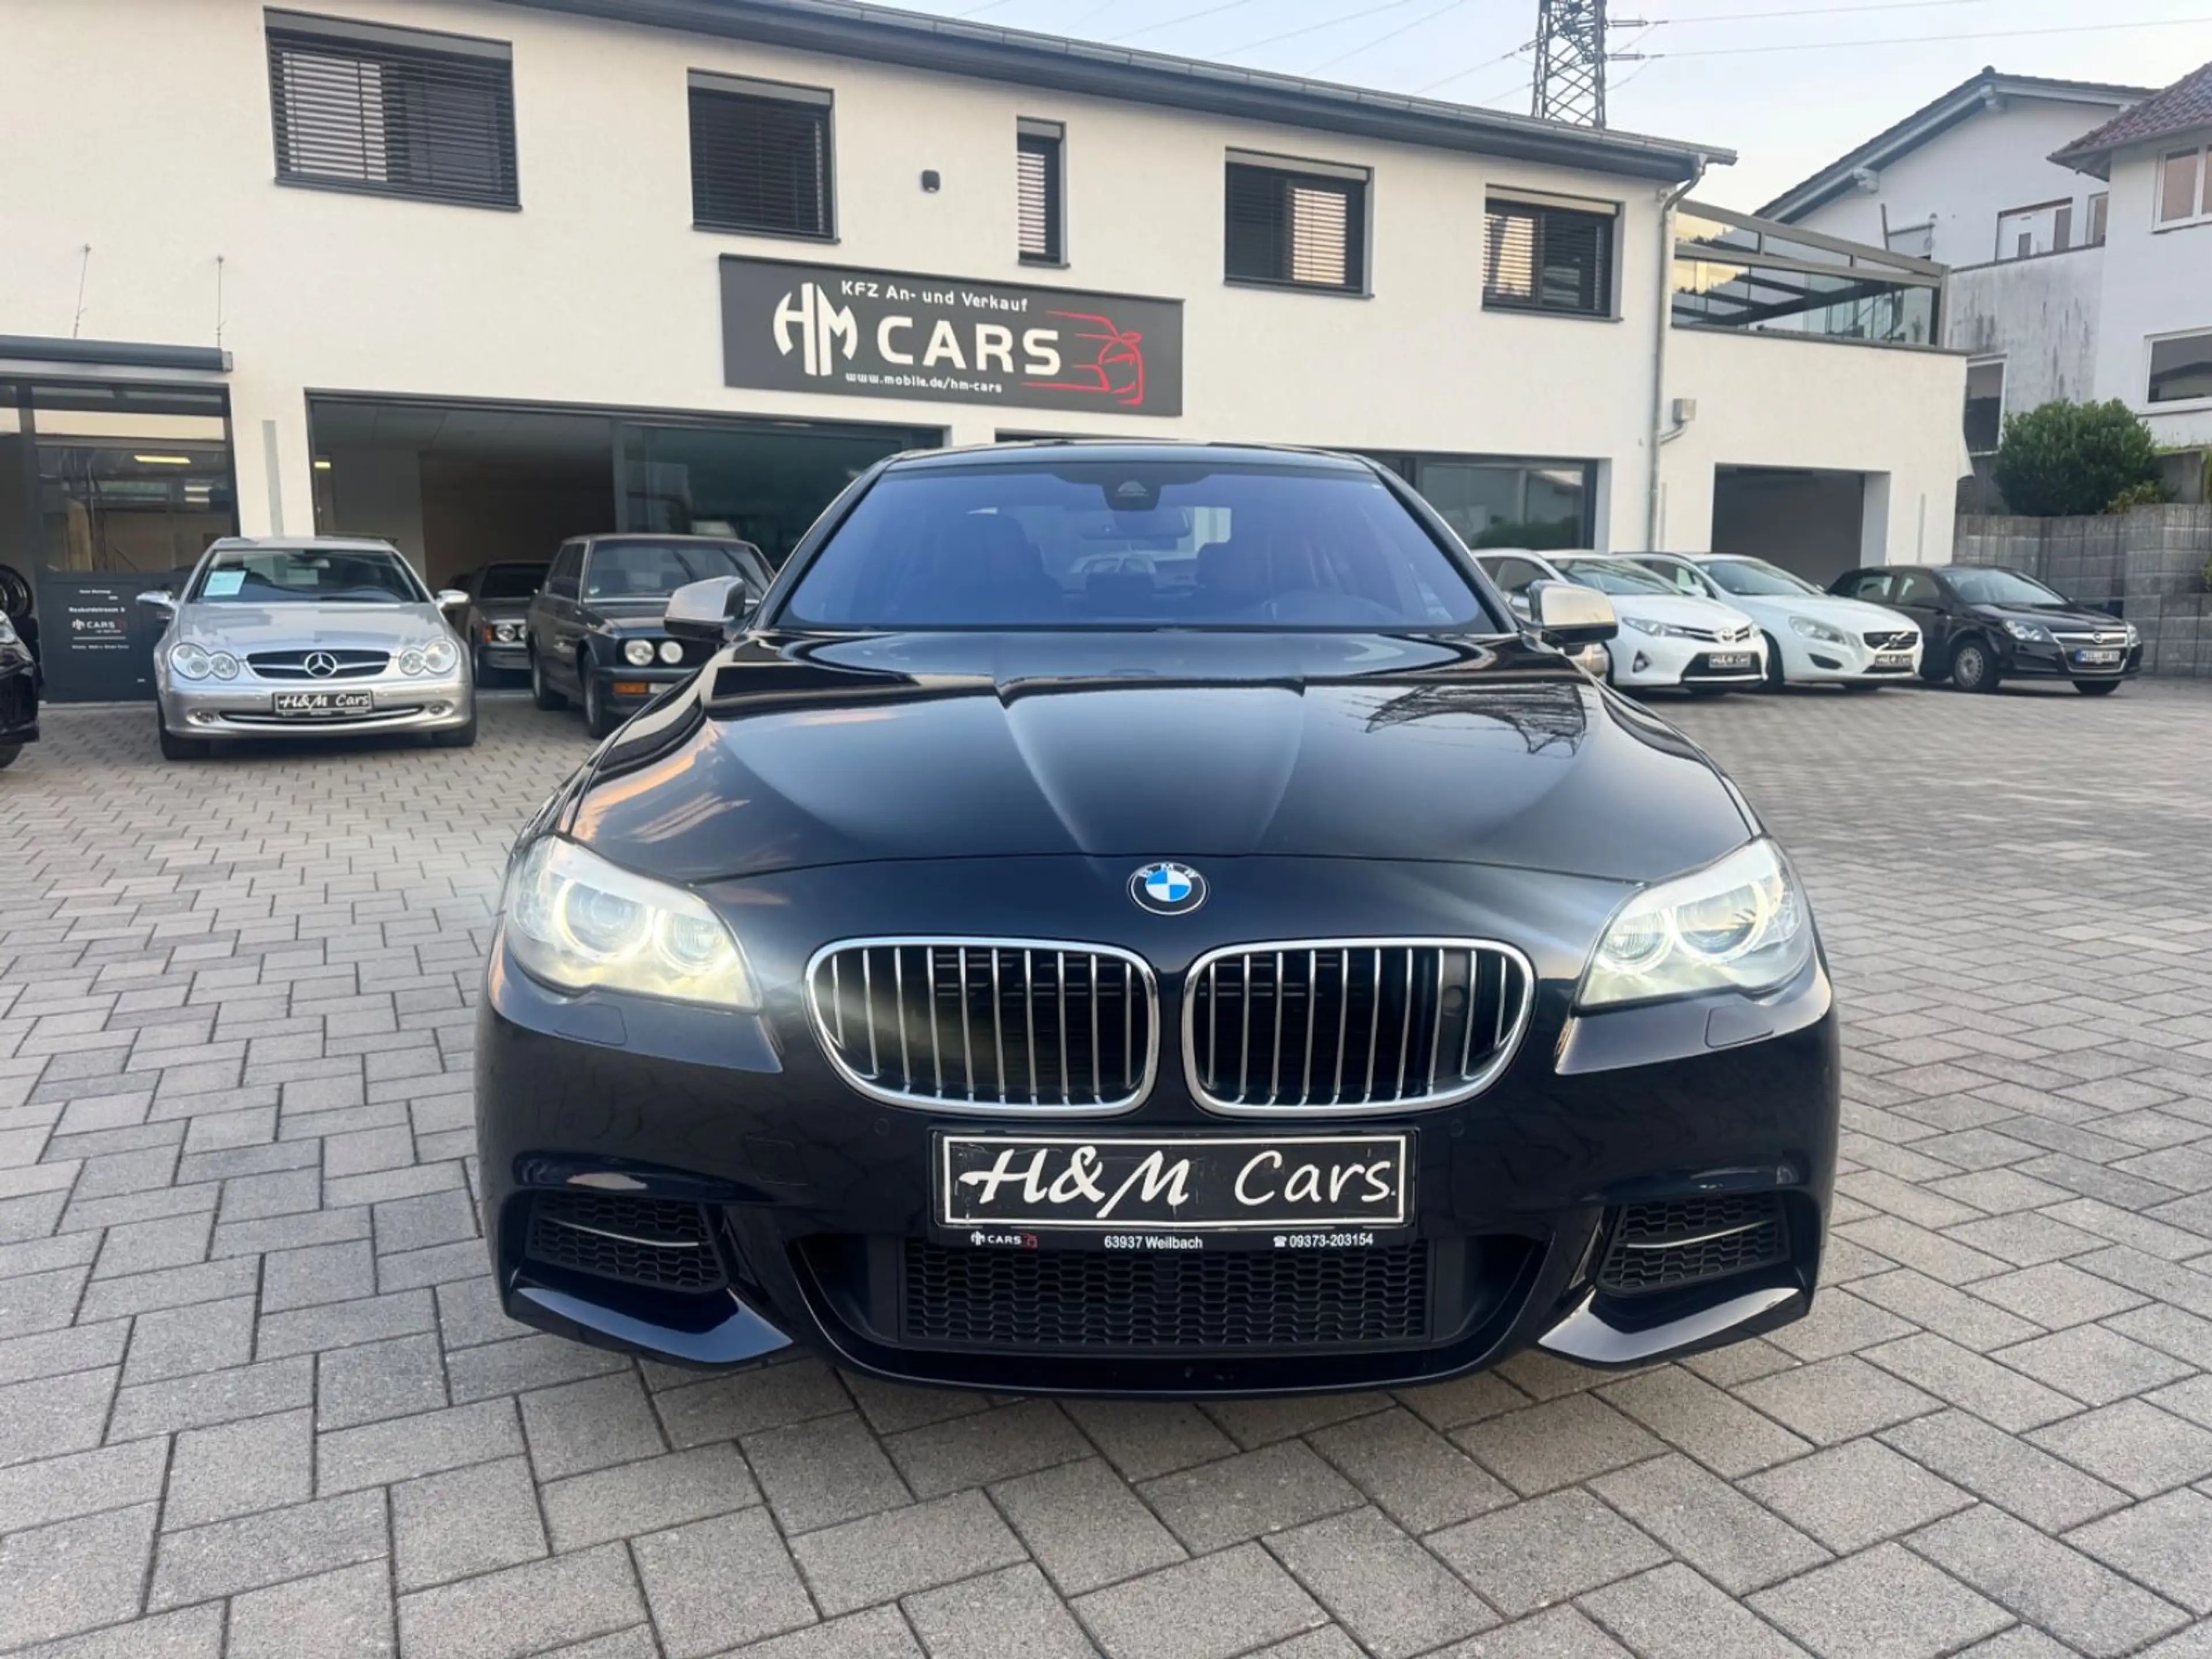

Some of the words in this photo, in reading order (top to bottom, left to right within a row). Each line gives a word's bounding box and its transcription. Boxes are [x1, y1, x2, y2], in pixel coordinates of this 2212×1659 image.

[841, 280, 880, 298] KFZ
[886, 286, 917, 300] An-
[923, 290, 955, 306] und
[962, 292, 1029, 312] Verkauf
[877, 315, 1061, 376] CARS
[845, 372, 1003, 393] www.mobile.de/hm-cars
[335, 694, 368, 706] Cars
[959, 1145, 1191, 1219] H&M
[1234, 1150, 1392, 1206] Cars
[987, 1235, 1022, 1245] CARS
[1104, 1235, 1143, 1249] 63937
[1145, 1235, 1203, 1249] Weilbach
[1289, 1233, 1374, 1248] 09373-203154
